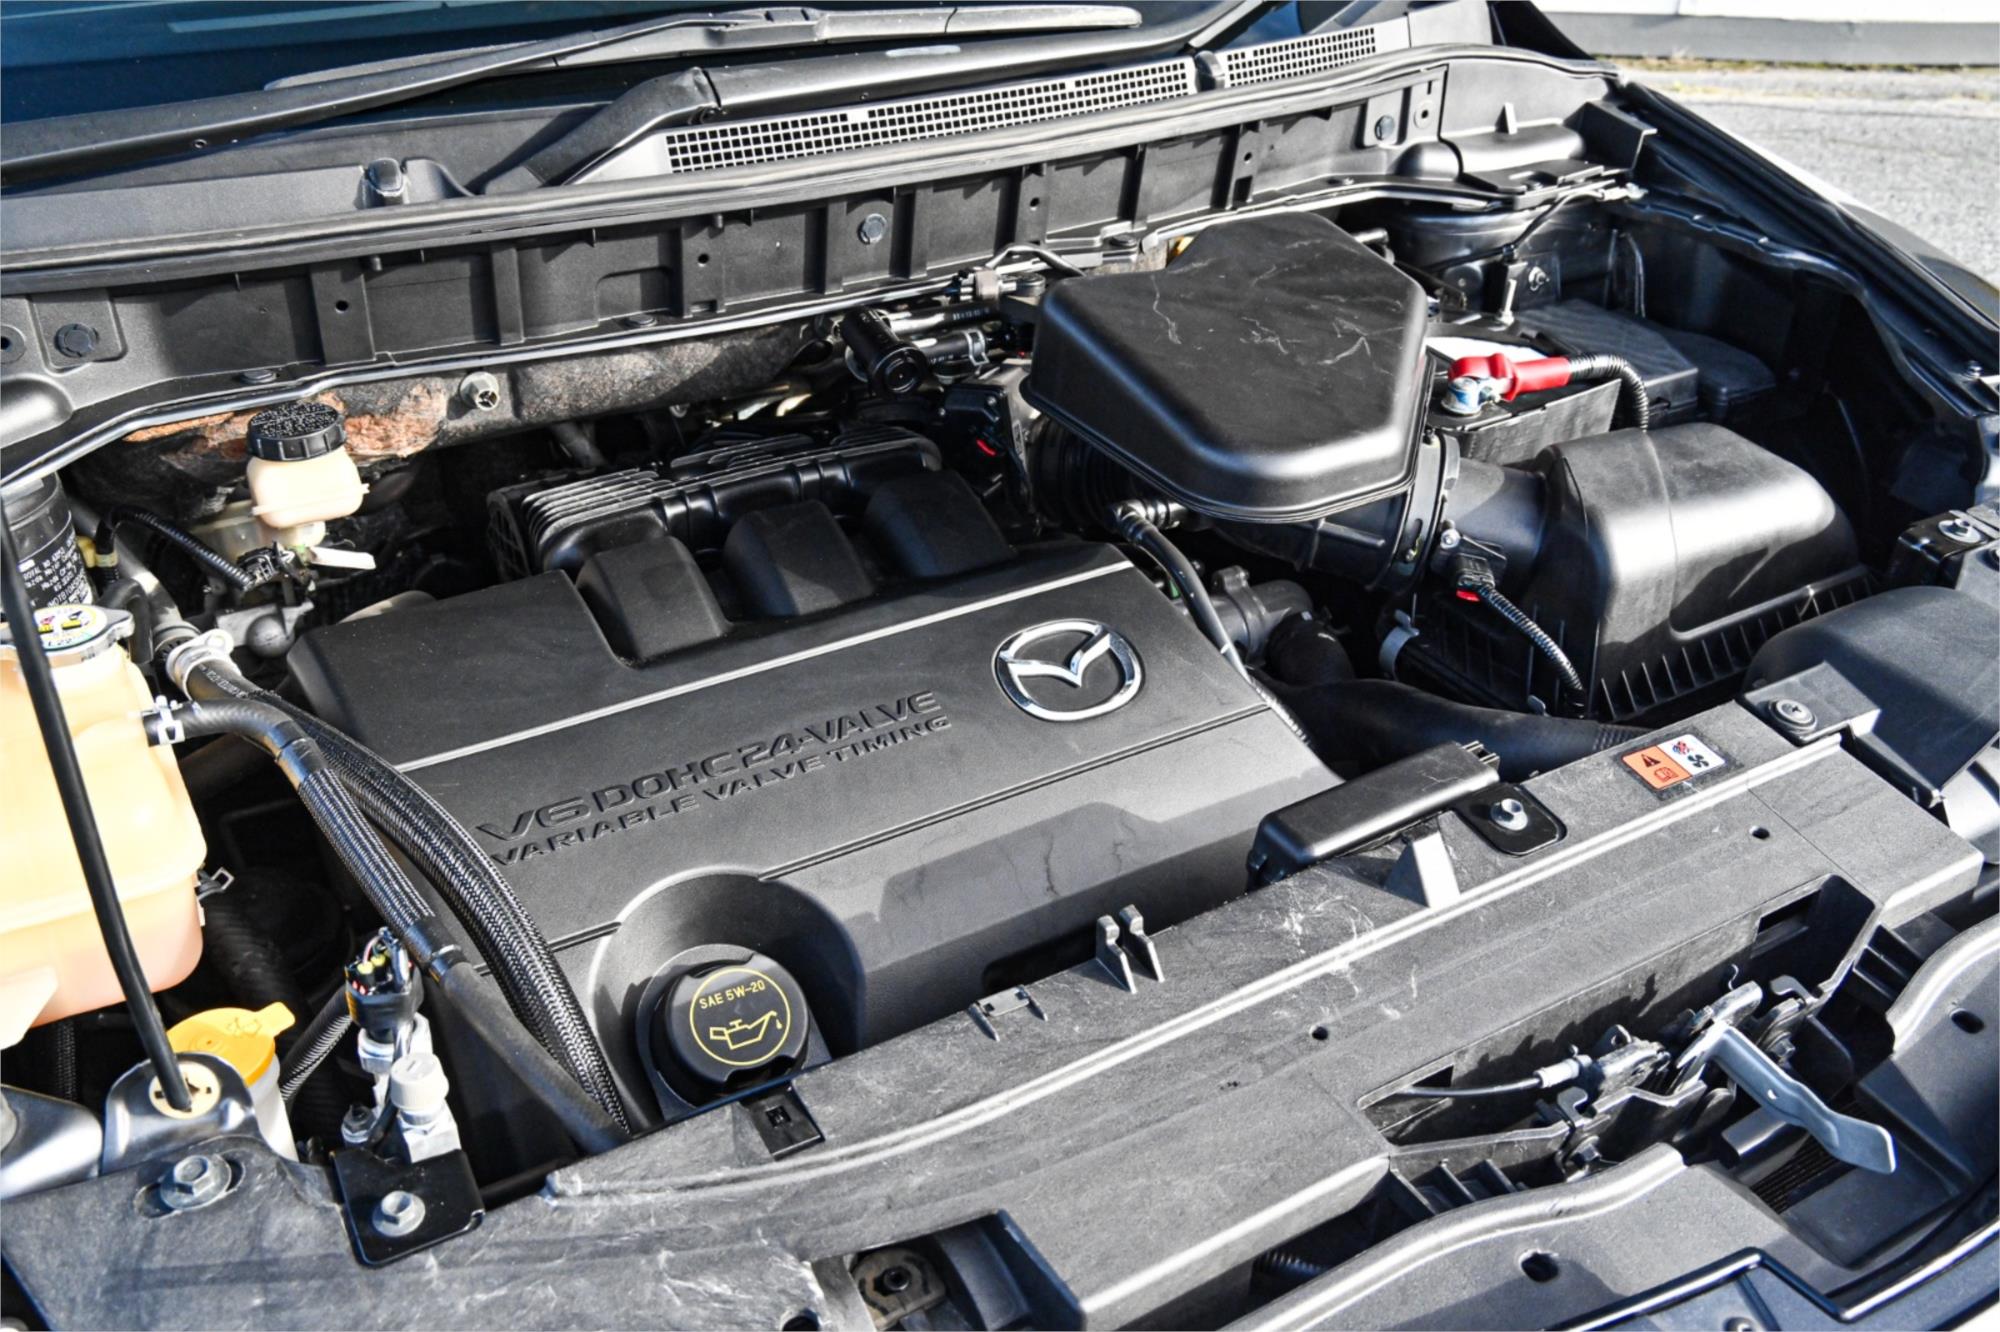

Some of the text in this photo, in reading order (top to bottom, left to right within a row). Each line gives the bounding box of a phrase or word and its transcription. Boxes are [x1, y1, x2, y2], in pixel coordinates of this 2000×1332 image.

[475, 690, 942, 842] V6 DOHC 24-VALVE
[490, 715, 952, 866] VARIABLE VALVE TIMING
[699, 979, 766, 1009] SAE 5W-20
